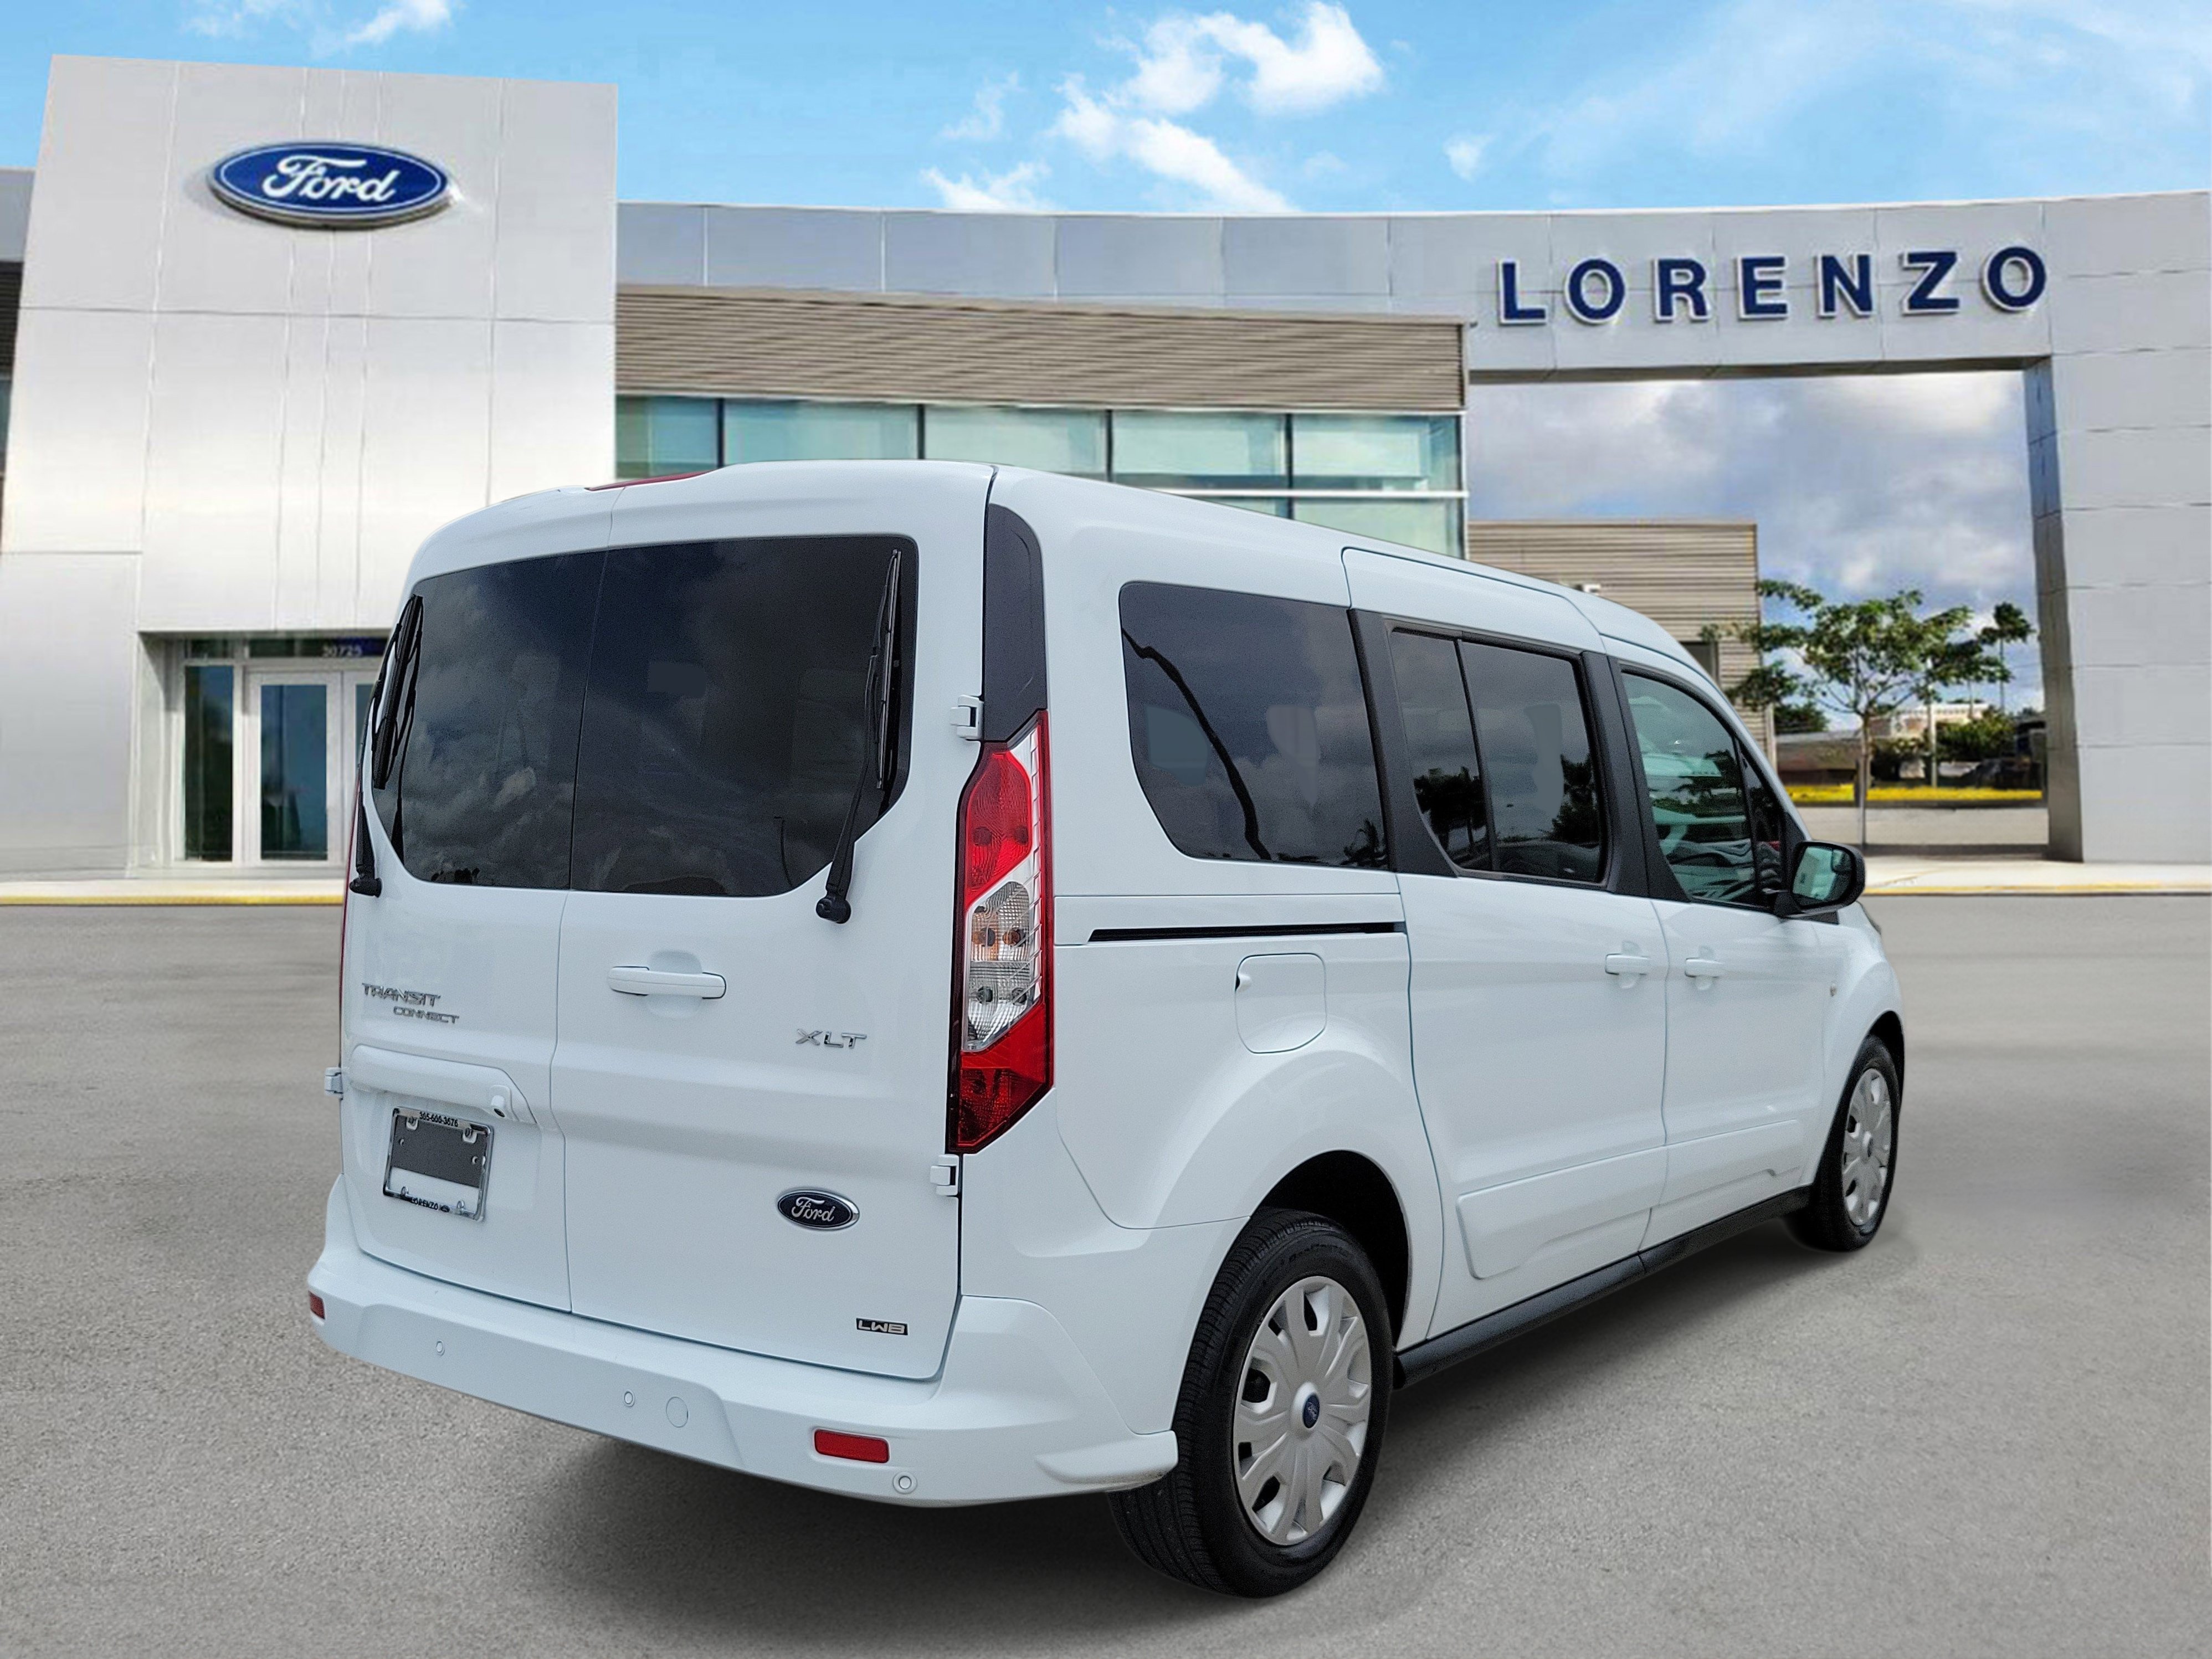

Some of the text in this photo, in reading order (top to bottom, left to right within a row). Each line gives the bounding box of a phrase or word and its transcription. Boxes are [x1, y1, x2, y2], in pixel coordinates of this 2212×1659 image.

[262, 154, 401, 202] Ford
[1498, 246, 2047, 323] LORENZO
[362, 983, 441, 1007] TRANSIT
[393, 1006, 459, 1024] CONNECT
[796, 1029, 867, 1049] XLT
[791, 1196, 836, 1222] Ford
[858, 1320, 905, 1334] LWB
